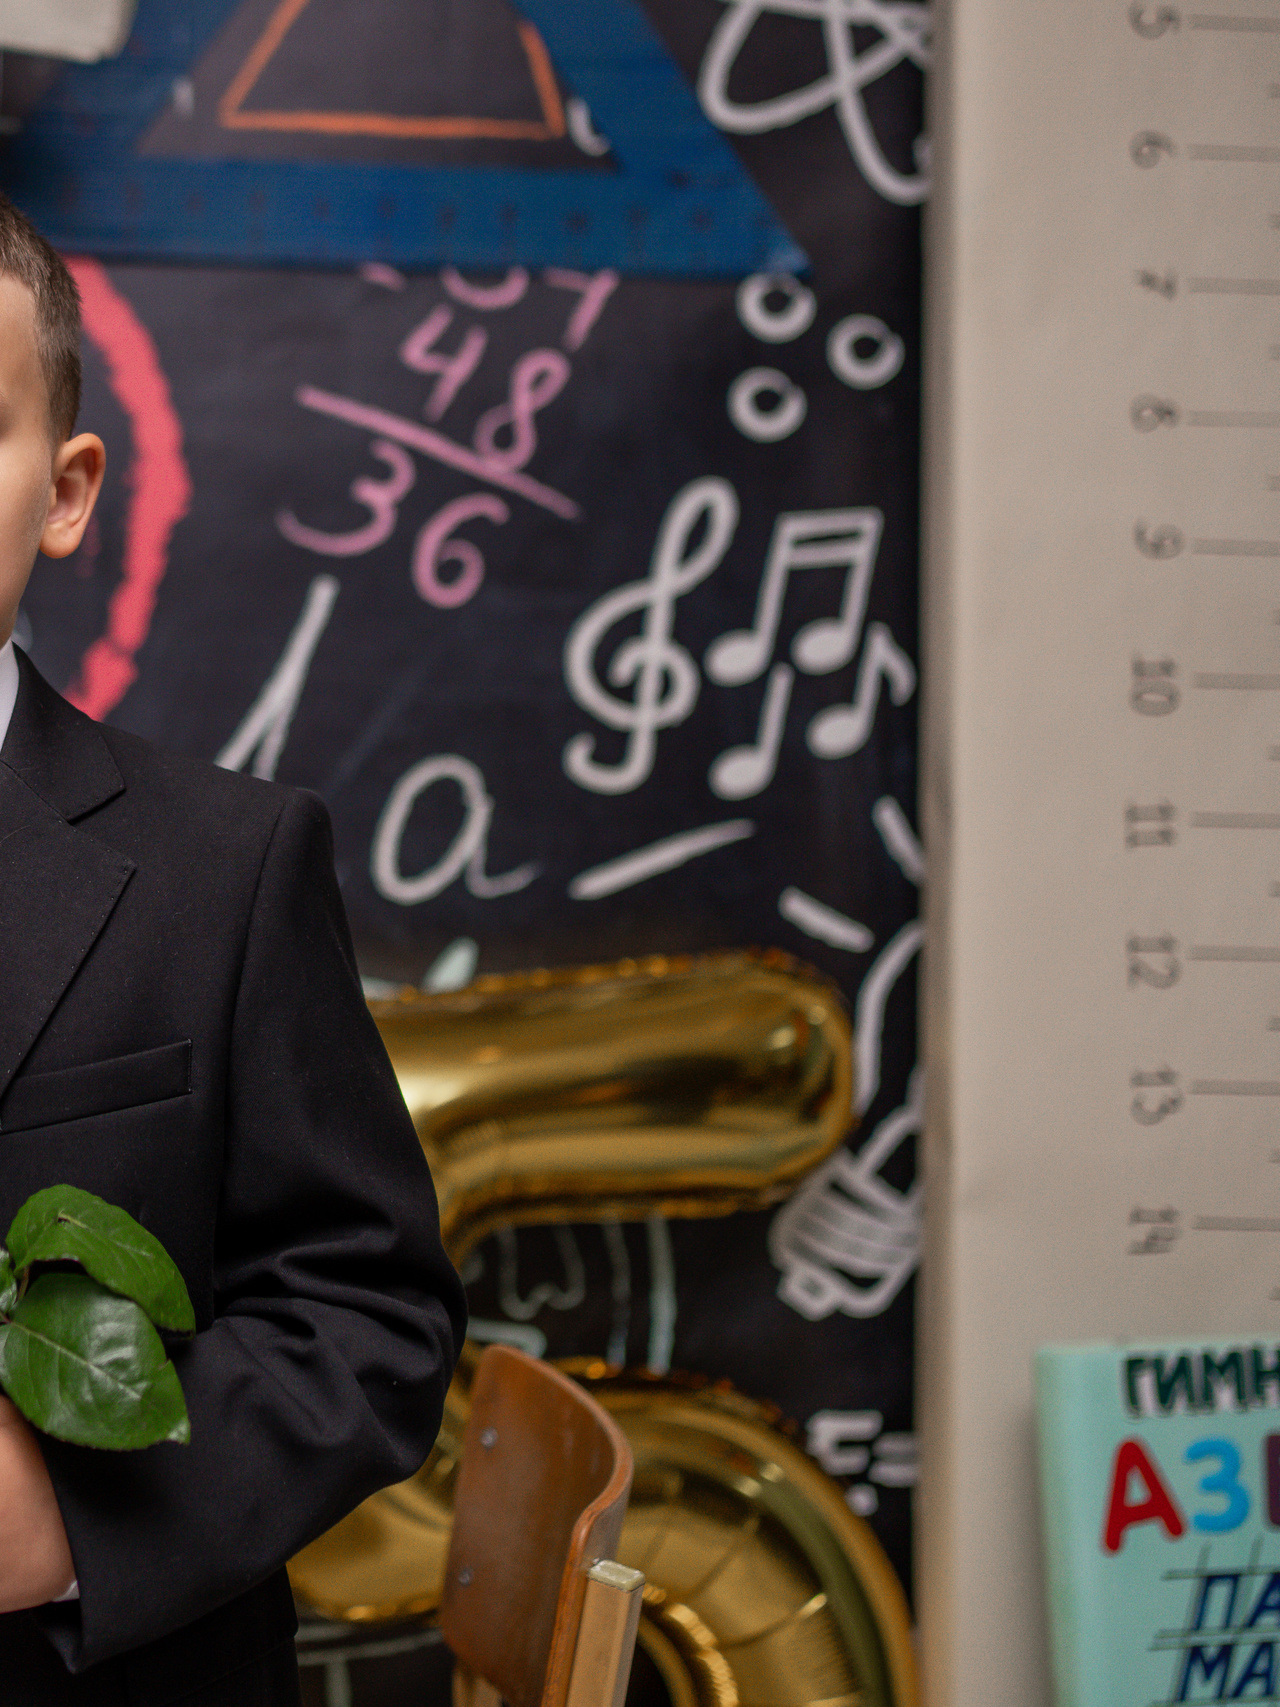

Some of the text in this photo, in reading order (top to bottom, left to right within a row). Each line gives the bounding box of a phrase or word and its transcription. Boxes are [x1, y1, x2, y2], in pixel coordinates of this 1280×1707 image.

[1129, 130, 1178, 170] 6
[1129, 651, 1180, 717] 10
[1125, 801, 1177, 849] 11
[1127, 933, 1181, 989] 12
[1128, 1066, 1183, 1126] 13
[1100, 1434, 1280, 1556] АЗ
